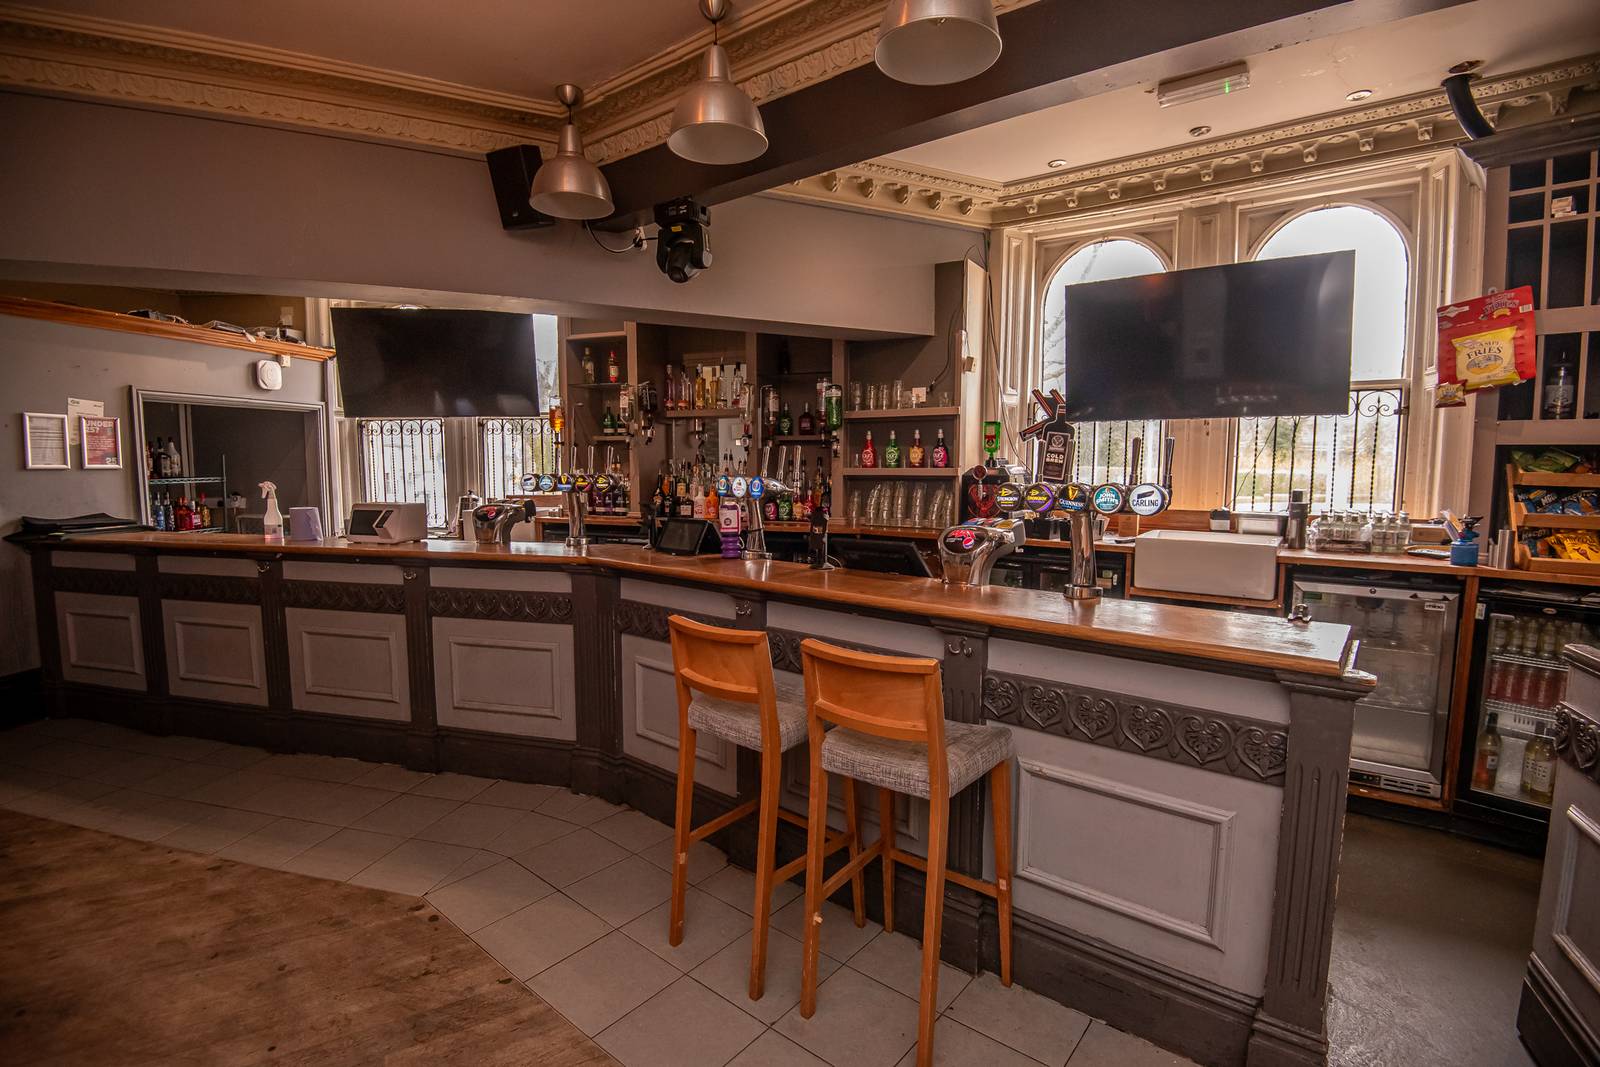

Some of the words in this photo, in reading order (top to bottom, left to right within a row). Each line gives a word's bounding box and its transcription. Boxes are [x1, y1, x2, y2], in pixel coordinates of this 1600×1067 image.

[1466, 346, 1503, 360] FRIES
[105, 457, 117, 465] 25
[1060, 498, 1084, 507] GUINNESS
